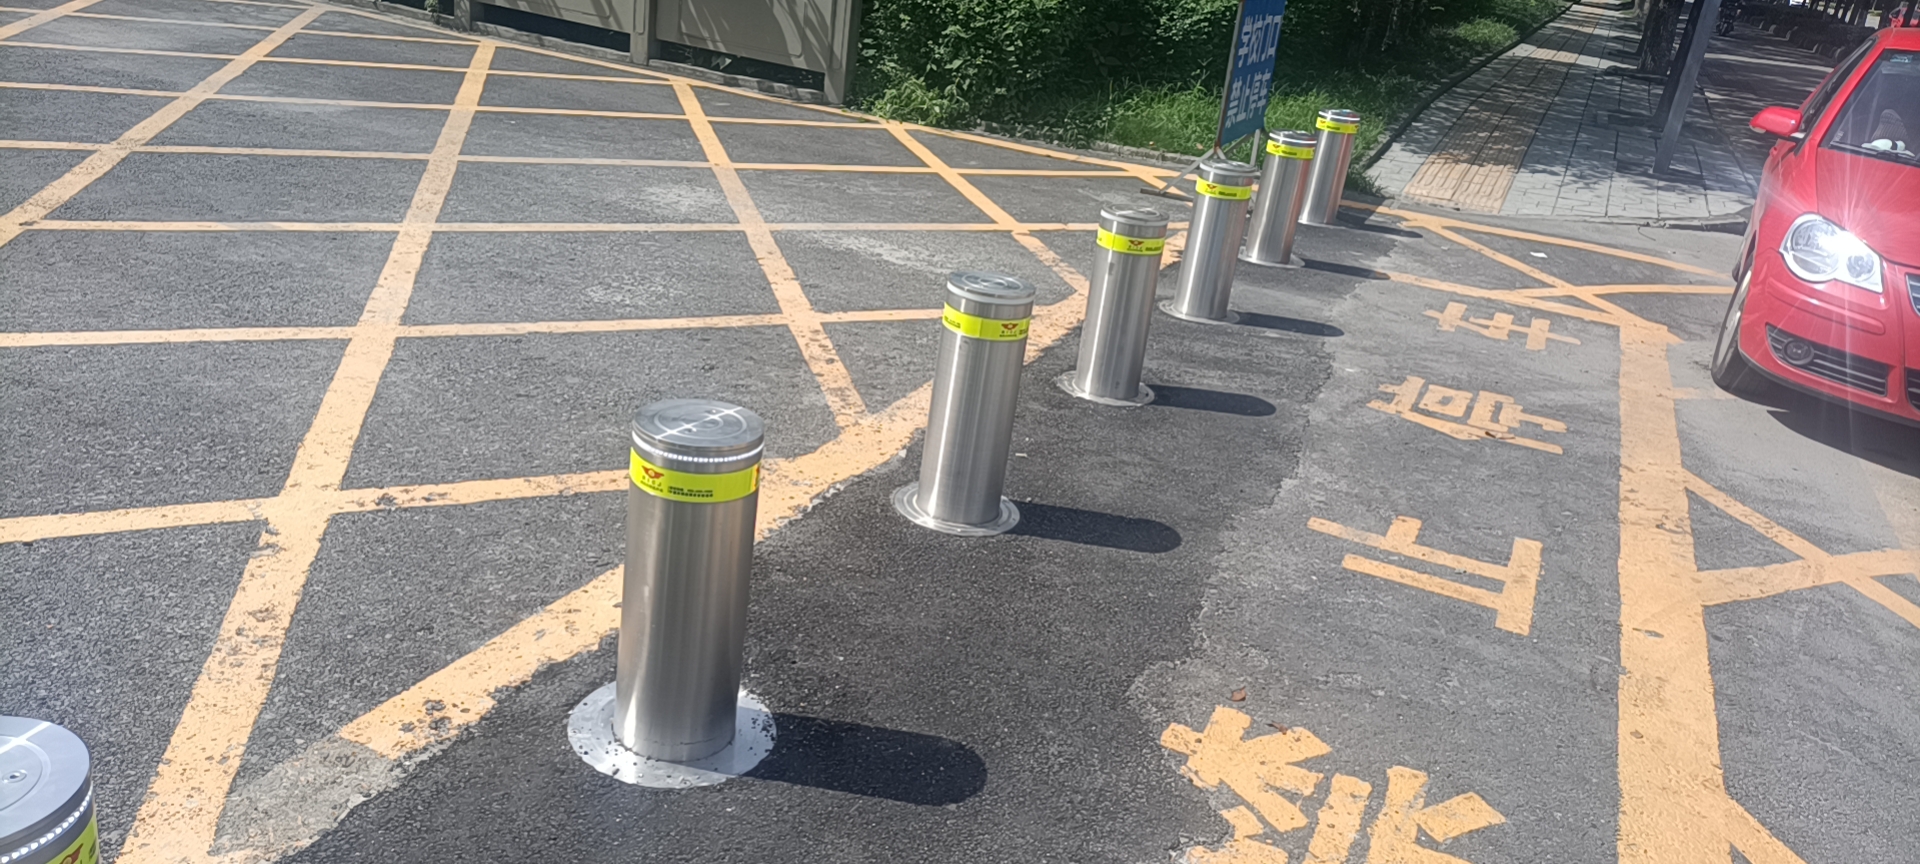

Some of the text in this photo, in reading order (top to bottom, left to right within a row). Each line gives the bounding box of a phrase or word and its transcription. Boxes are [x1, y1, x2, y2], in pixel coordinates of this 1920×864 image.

[1238, 13, 1283, 68] 学校门口
[1225, 68, 1272, 128] 禁止停车
